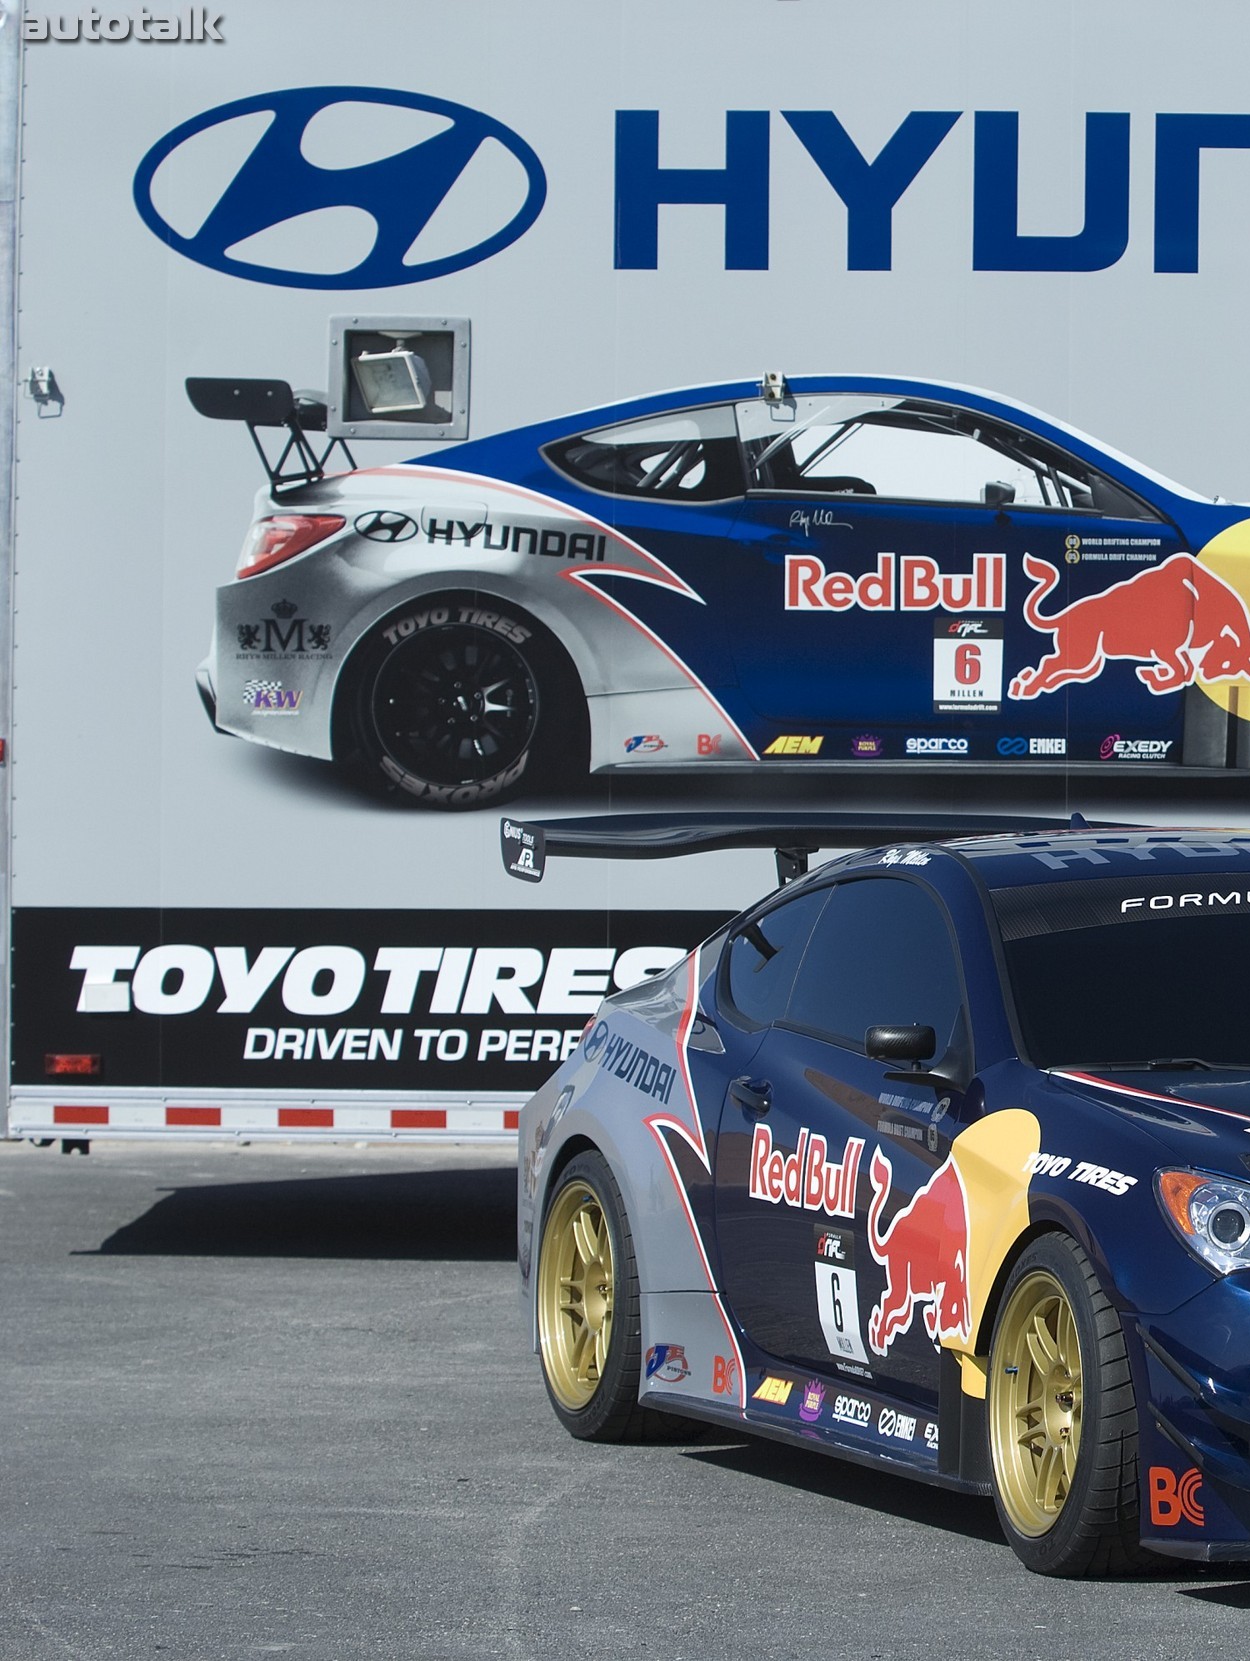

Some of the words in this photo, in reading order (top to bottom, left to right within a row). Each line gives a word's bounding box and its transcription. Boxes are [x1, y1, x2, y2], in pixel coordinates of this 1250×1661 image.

[428, 518, 607, 562] HYUNDAI
[1081, 538, 1102, 546] WORLD
[1103, 538, 1129, 546] DRIFTING
[1130, 538, 1161, 546] CHAMPION
[1081, 553, 1108, 561] FORMULA
[1109, 553, 1125, 561] DRIFT
[785, 553, 895, 611] Red
[900, 553, 1006, 612] Bull
[260, 618, 310, 652] M
[383, 606, 450, 646] TOYO
[457, 606, 532, 645] TIRES
[955, 643, 981, 685] 6
[254, 690, 303, 708] KW
[762, 736, 825, 754] AEM
[906, 737, 968, 754] sparco
[1029, 738, 1067, 754] ENKEI
[1113, 740, 1173, 753] EXEDY
[379, 750, 528, 803] PROXES
[69, 944, 366, 1015] TOYO
[243, 1028, 403, 1061] DRIVEN
[413, 1028, 470, 1061] TO
[601, 1033, 677, 1105] HYUNDAI
[749, 1122, 810, 1208] Red
[803, 1132, 866, 1219] Bull
[1021, 1152, 1072, 1177] TOYO
[1067, 1161, 1139, 1196] TIRES
[831, 1272, 843, 1333] 6
[752, 1376, 794, 1406] AEM
[832, 1395, 872, 1425] sparco
